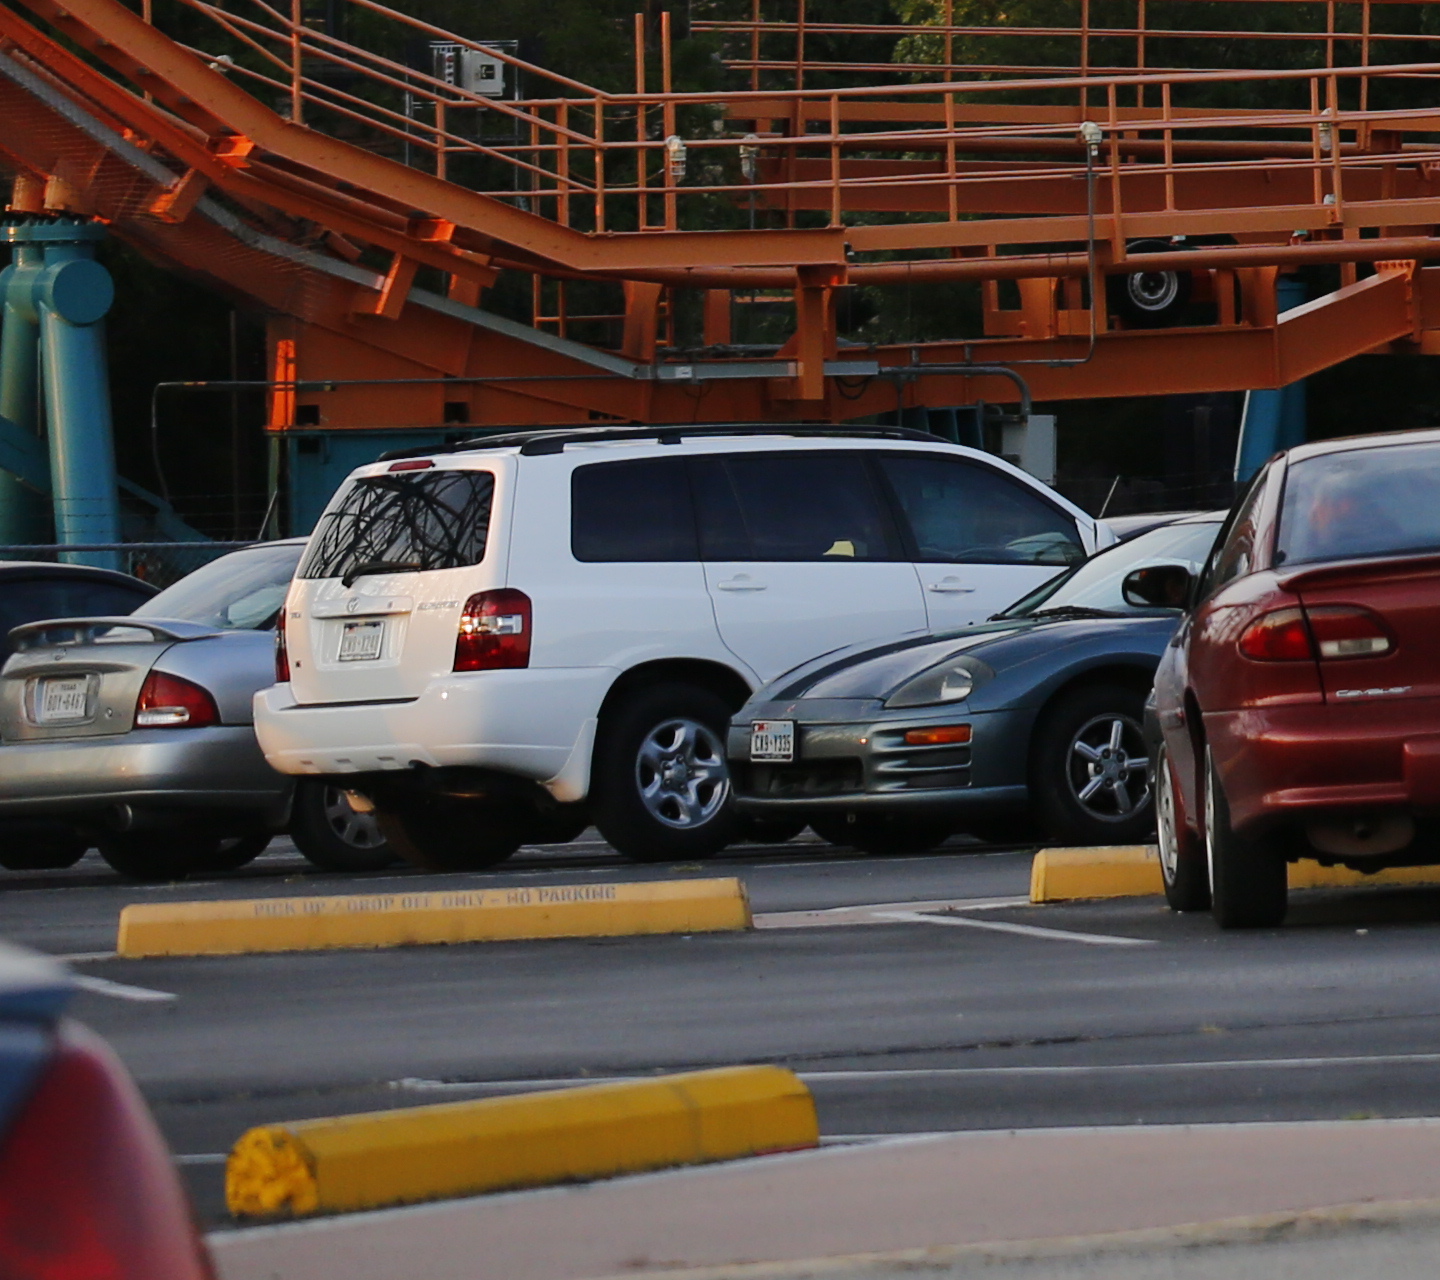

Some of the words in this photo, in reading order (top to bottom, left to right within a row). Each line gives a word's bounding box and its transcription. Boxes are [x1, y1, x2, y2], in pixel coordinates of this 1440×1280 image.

[347, 897, 394, 911] DROP
[506, 890, 530, 905] NO
[538, 886, 617, 903] PARKING
